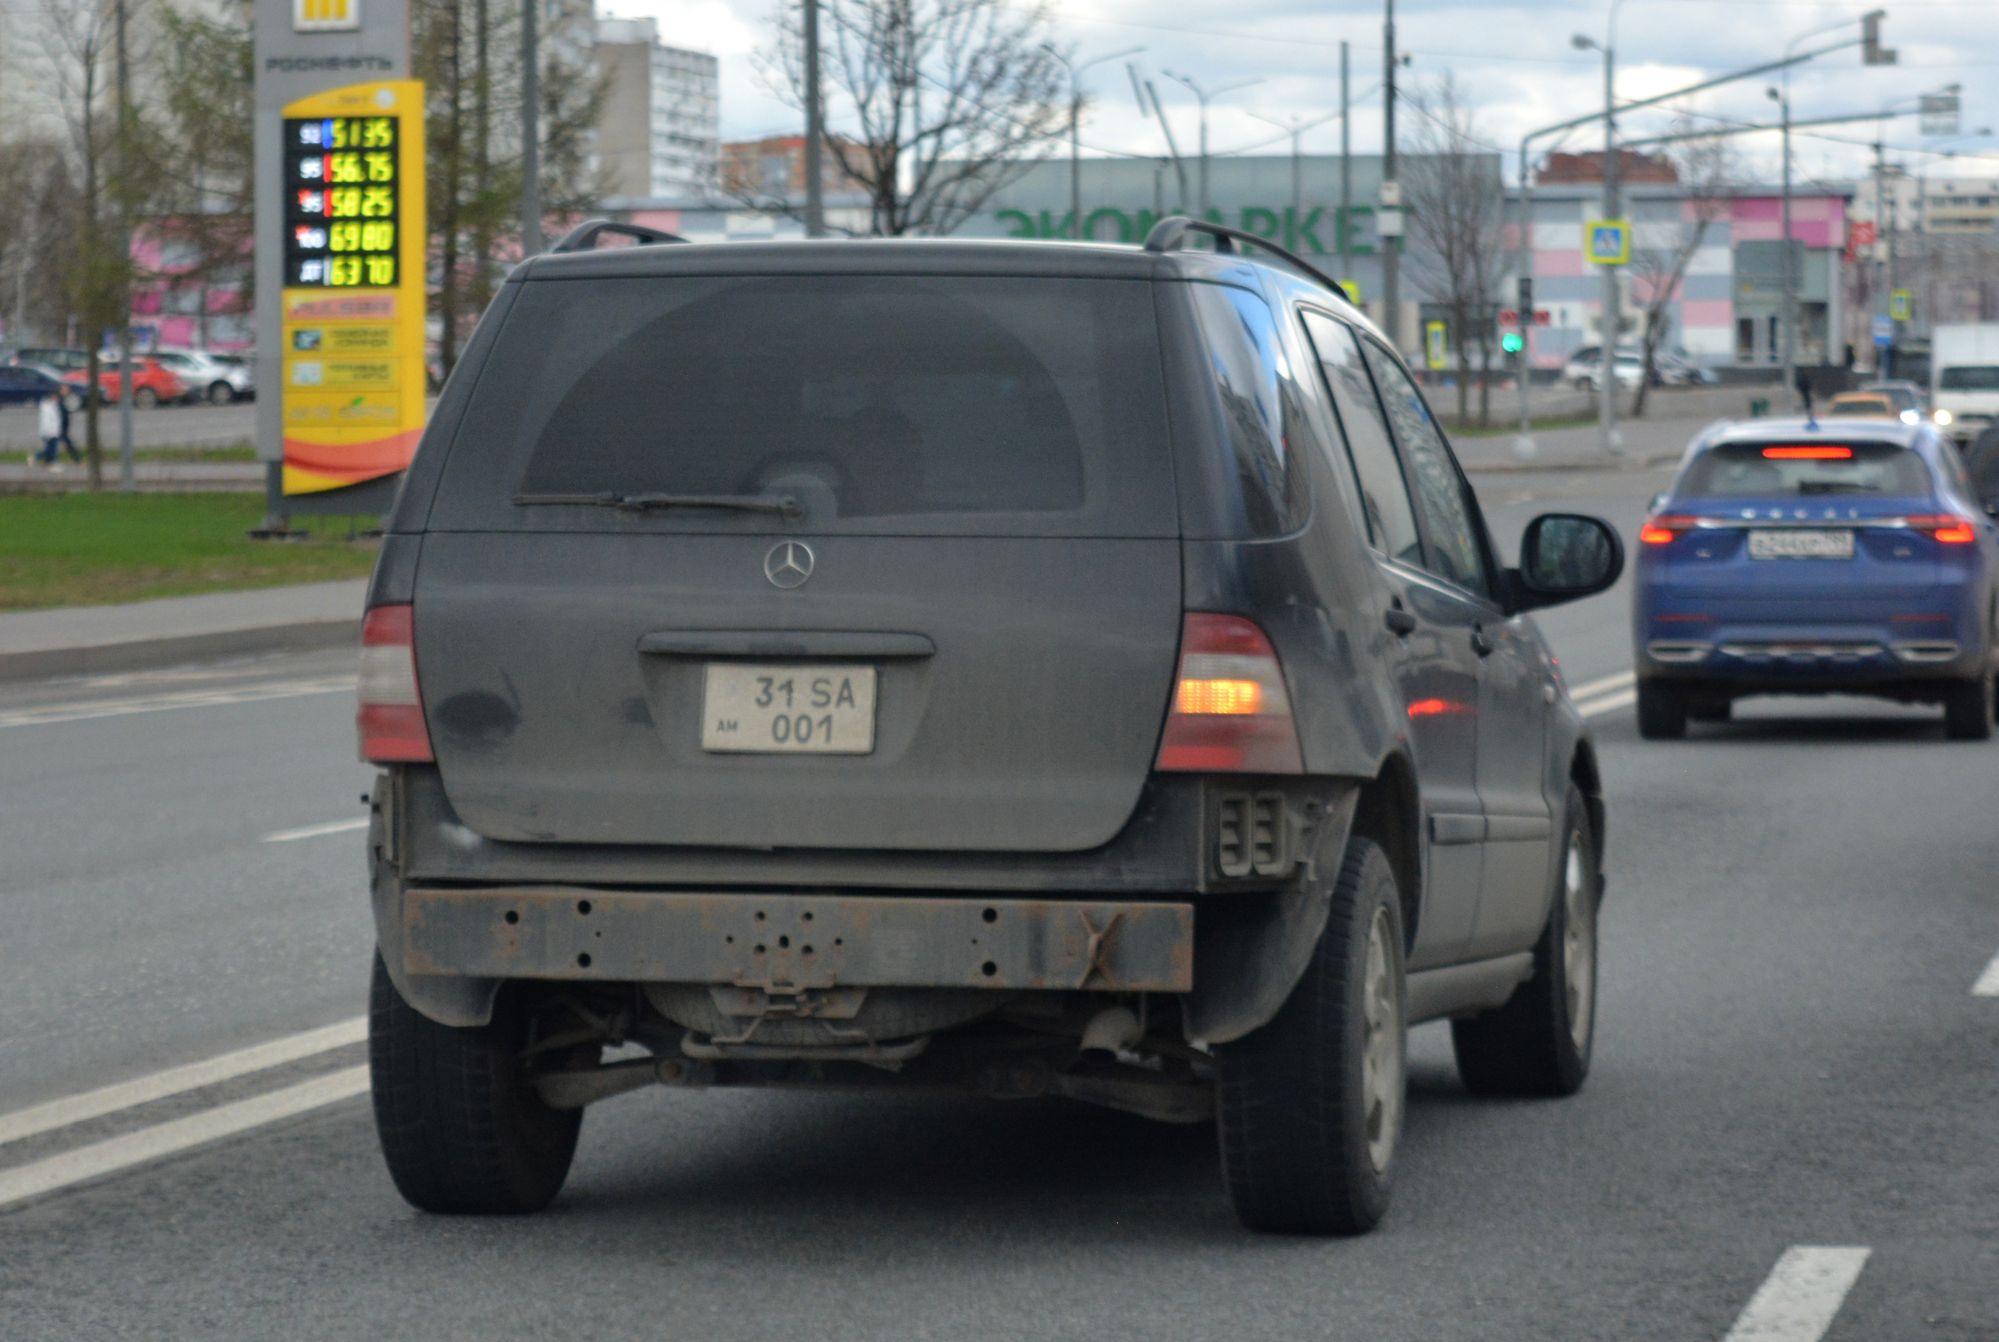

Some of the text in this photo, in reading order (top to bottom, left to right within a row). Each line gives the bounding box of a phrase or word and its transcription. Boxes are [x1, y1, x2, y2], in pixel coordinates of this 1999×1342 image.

[300, 157, 323, 179] 95
[994, 206, 1410, 255] ЭКОАРКЕ
[755, 676, 855, 709] 31 SA
[716, 714, 833, 744] AM 001
